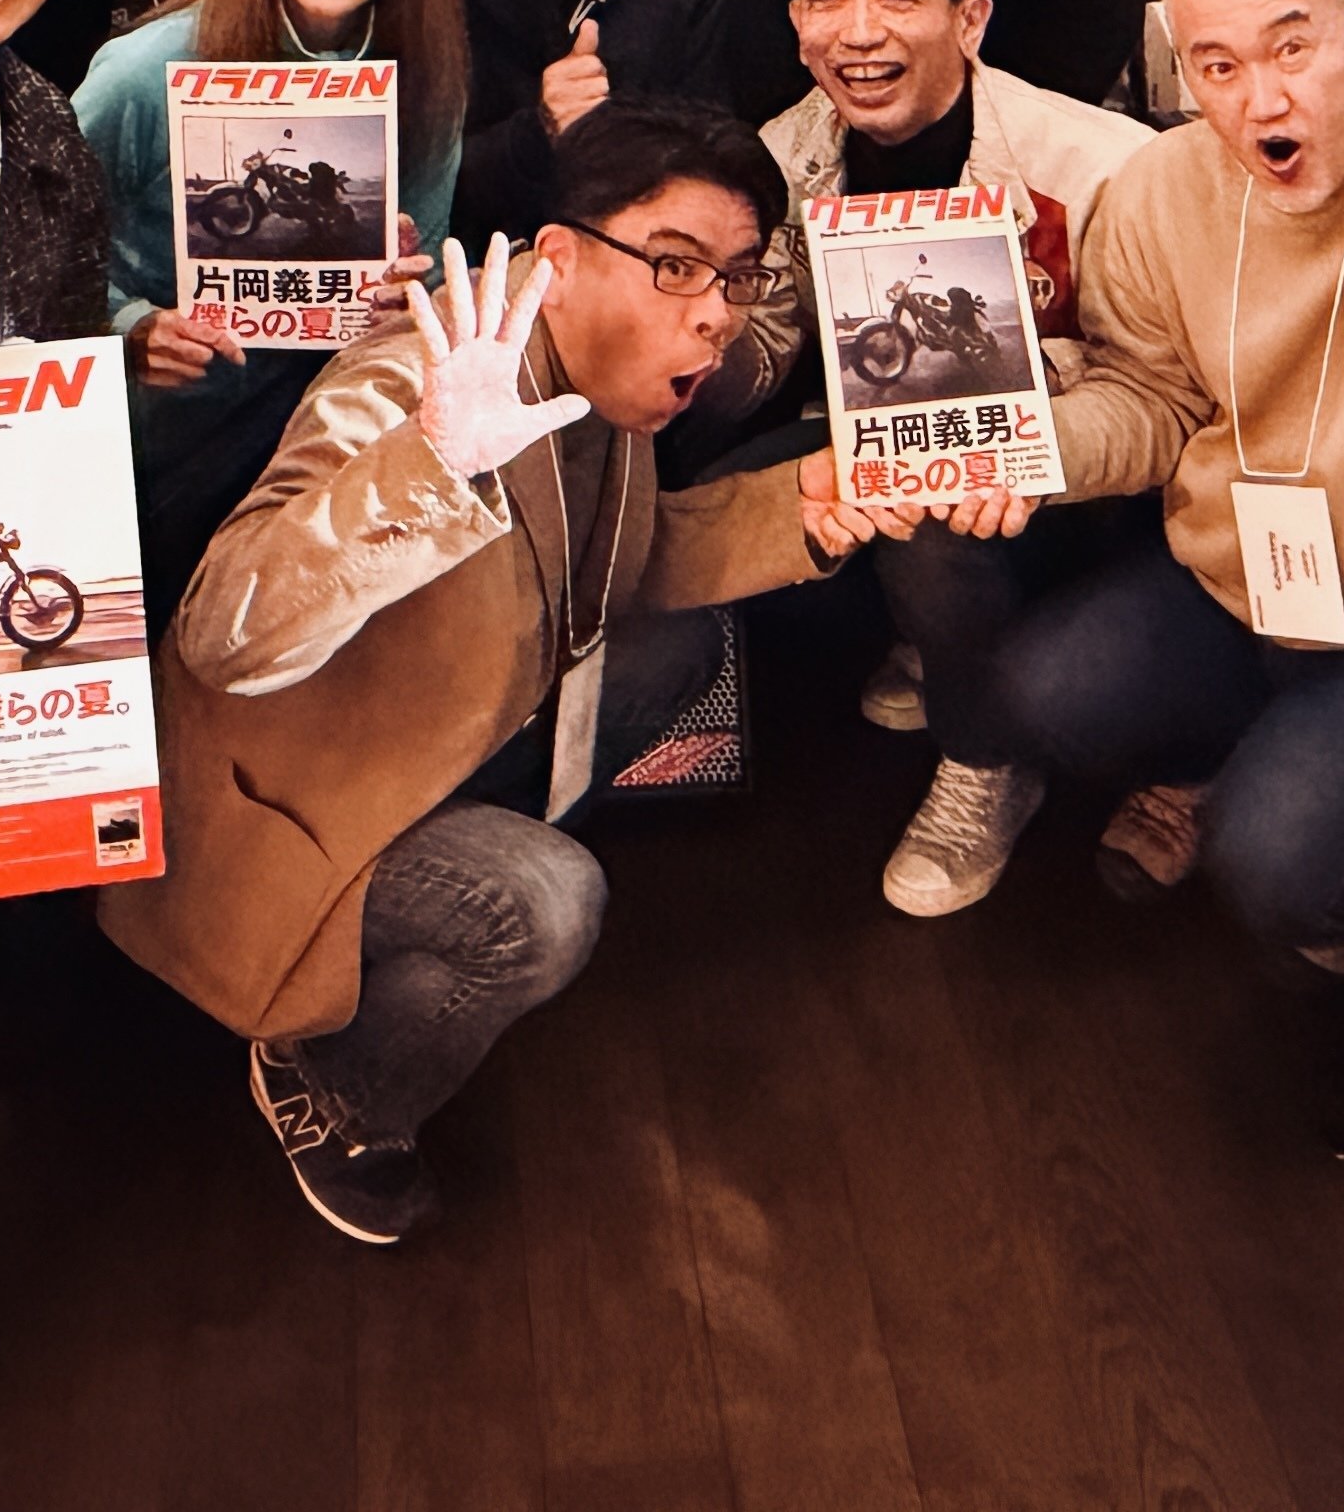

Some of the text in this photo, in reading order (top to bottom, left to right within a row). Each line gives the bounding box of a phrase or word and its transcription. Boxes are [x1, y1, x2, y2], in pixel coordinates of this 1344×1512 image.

[193, 264, 382, 304] 片岡義男と
[852, 403, 1042, 458] 片岡義男と
